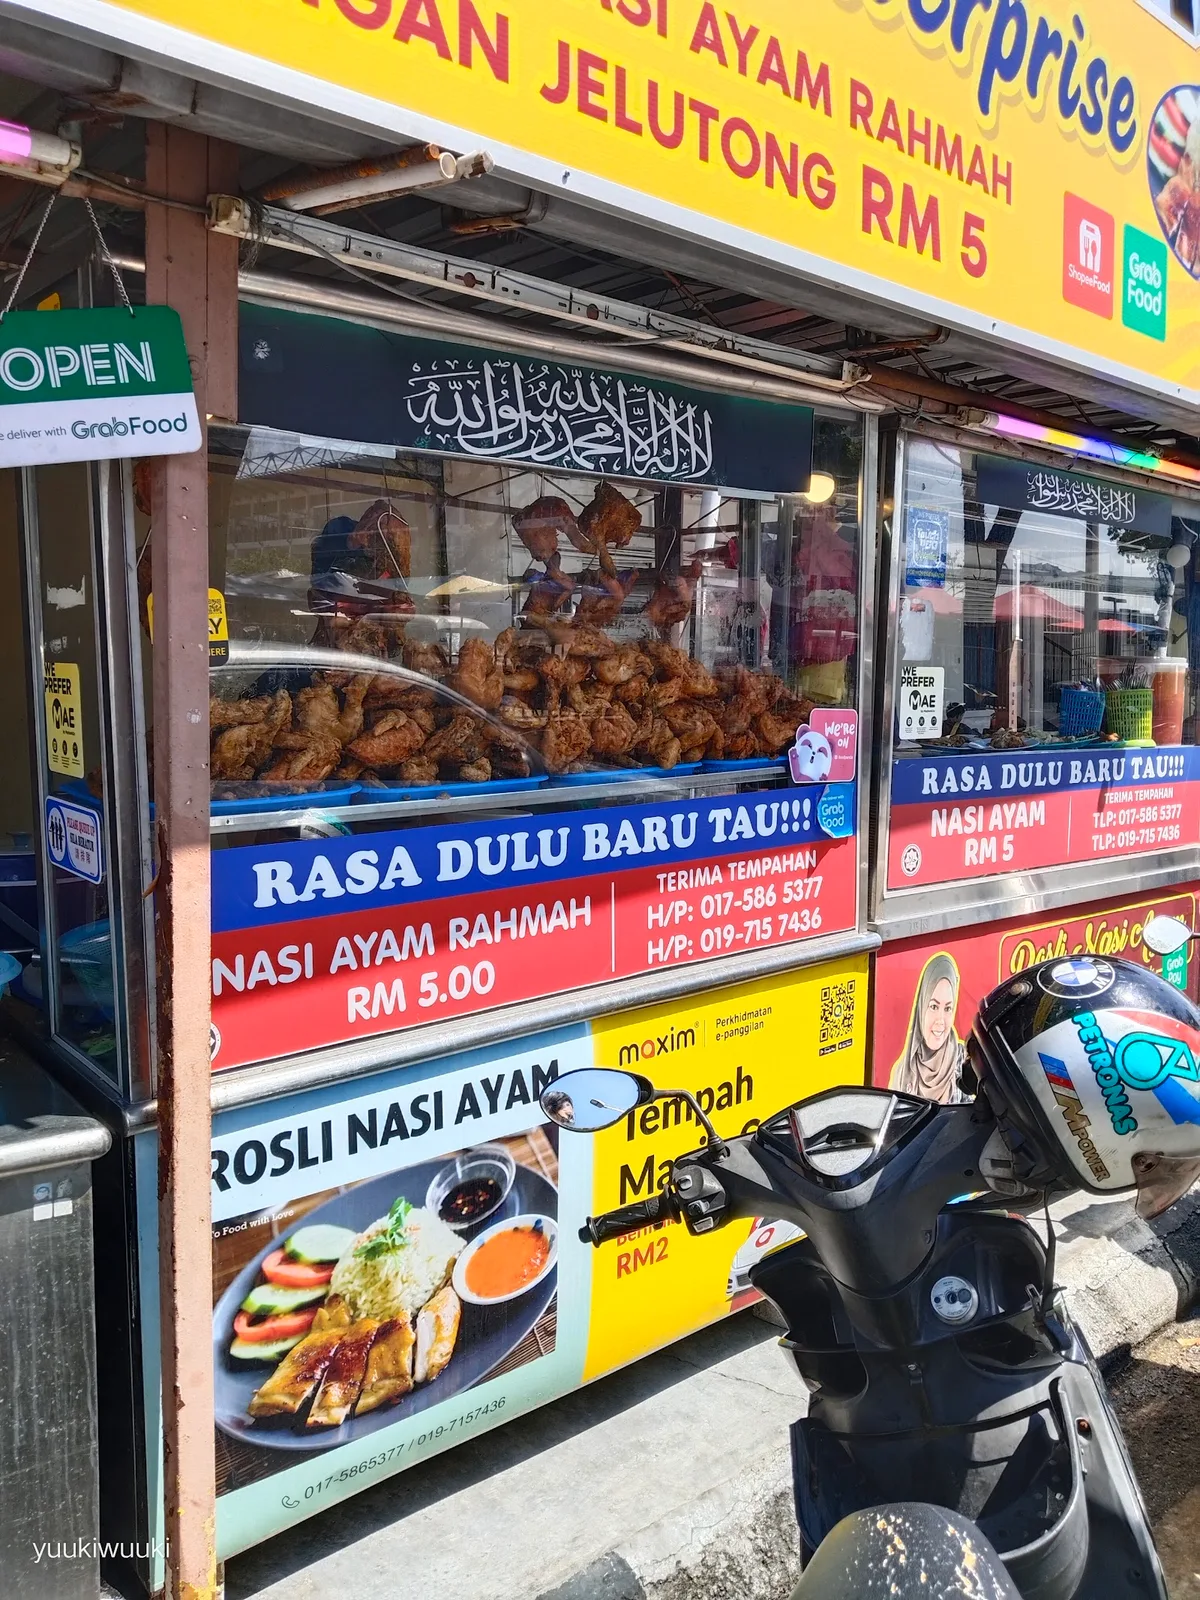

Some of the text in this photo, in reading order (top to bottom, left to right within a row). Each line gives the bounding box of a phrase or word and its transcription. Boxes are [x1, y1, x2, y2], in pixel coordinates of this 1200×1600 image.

[873, 0, 1137, 154] rprise
[600, 0, 1012, 206] SI AYAM RAHMAH
[540, 39, 836, 211] JELUTONG
[862, 163, 942, 264] RM
[960, 211, 987, 279] 5
[1068, 264, 1110, 294] ShopeeFood
[1129, 252, 1162, 289] Grab
[1128, 278, 1162, 316] Food
[0, 342, 156, 391] OPEN
[7, 429, 42, 440] deliver
[45, 427, 67, 437] with
[71, 413, 188, 440] GrabFood
[44, 662, 55, 676] WE
[44, 677, 72, 695] PREFER
[900, 676, 935, 688] PREFER
[902, 667, 917, 676] WE
[921, 754, 1185, 795] RASA DULU BARU TAU!!!
[822, 802, 844, 816] Grab
[1104, 787, 1173, 804] TERIMA TEMPAHAN
[931, 800, 1045, 837] NASI AYAM
[1093, 803, 1182, 828] TLP: 017-586 5377
[252, 798, 811, 908] RASA DULU BARU TAU!!!
[964, 834, 1014, 866] RM 5
[1092, 825, 1180, 851] TLP: 019-715 7436
[656, 850, 817, 893] TERIMA TEMPAHAN
[648, 875, 823, 929] H/P: 017-586 5377
[212, 895, 592, 996] NASI AYAM RAHMAH
[648, 907, 822, 965] H/P: 019-715 7436
[1075, 919, 1129, 956] Nasi
[1167, 955, 1184, 971] Grab
[347, 960, 495, 1023] RM 5.00
[716, 1005, 772, 1029] Perkhidmatan
[716, 1020, 764, 1042] e-panggilan
[1071, 1011, 1138, 1136] PETRONAS
[211, 1059, 559, 1193] ROSLI NASI AYAM
[222, 1222, 247, 1236] Food
[249, 1216, 270, 1228] with
[271, 1209, 295, 1222] Love
[617, 1237, 668, 1279] RM2
[304, 1444, 405, 1500] 017-5865377
[417, 1396, 506, 1446] 019-7157436
